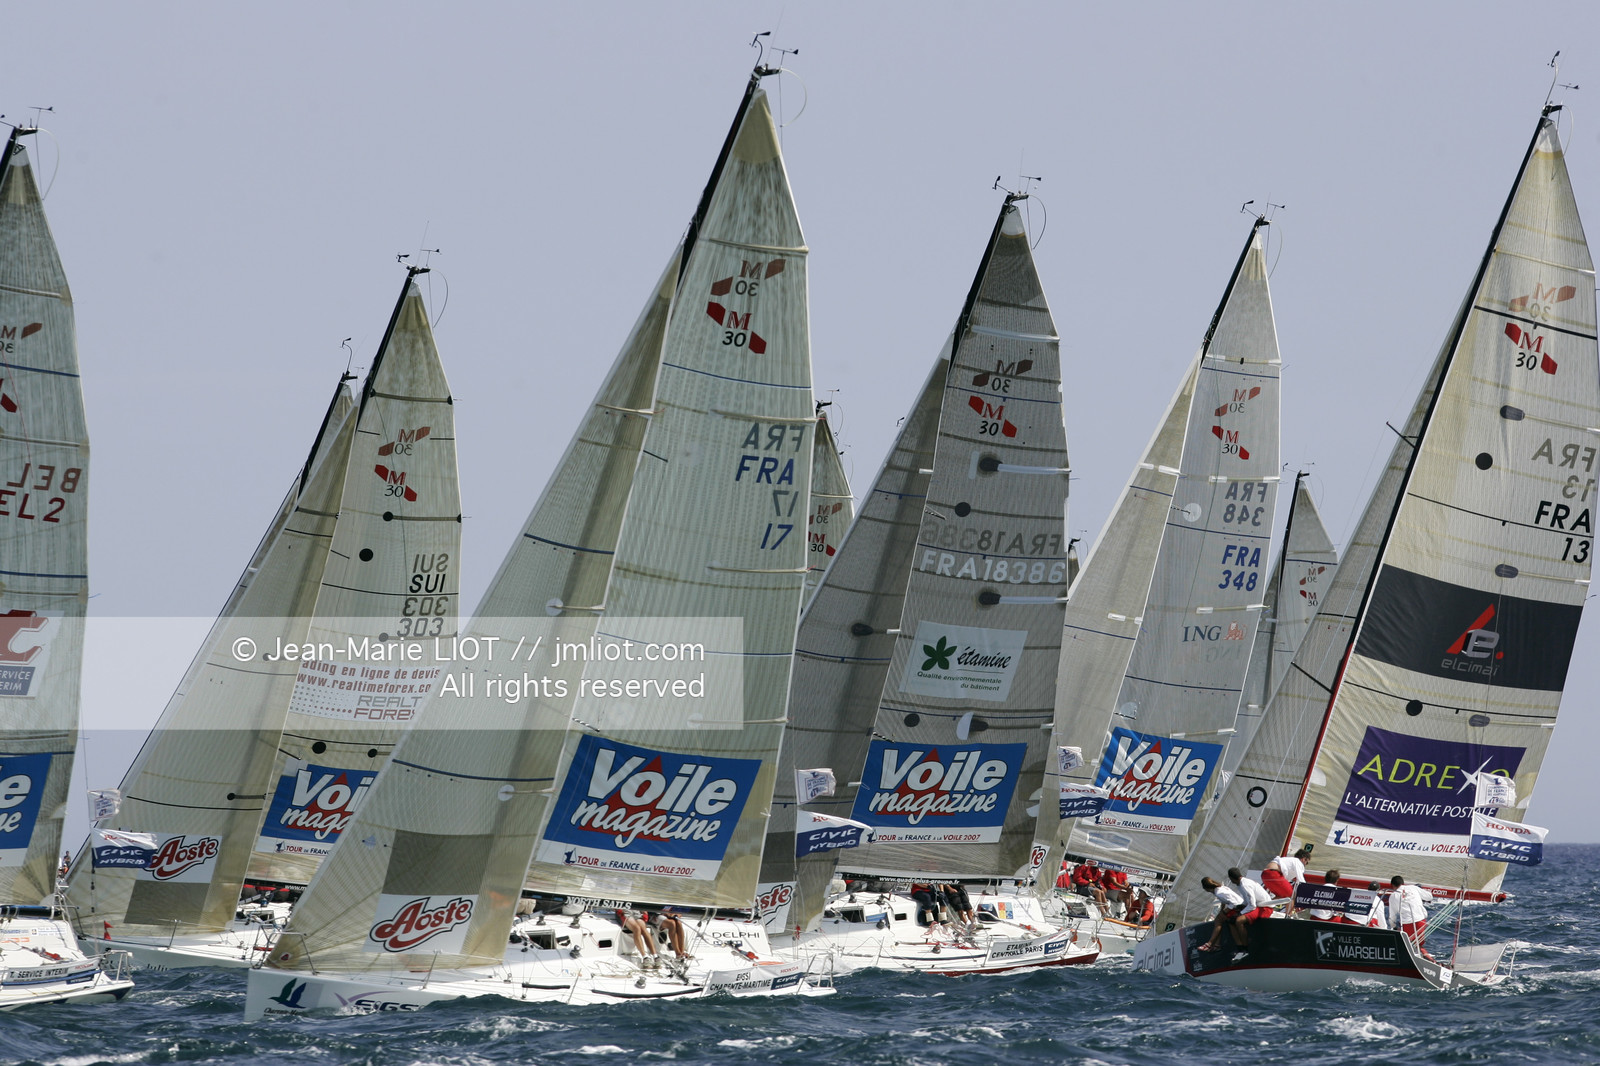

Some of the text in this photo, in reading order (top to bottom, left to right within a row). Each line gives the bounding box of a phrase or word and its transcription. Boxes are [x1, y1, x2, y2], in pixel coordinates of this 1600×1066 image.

[727, 311, 752, 330] M
[722, 331, 746, 347] 30
[1519, 331, 1544, 353] M
[1516, 352, 1537, 370] 30
[982, 403, 1005, 420] M
[979, 421, 999, 436] 30
[1225, 430, 1239, 443] M
[1222, 443, 1238, 454] 30
[388, 471, 406, 485] M
[735, 455, 794, 485] FRA
[384, 485, 404, 497] 30
[43, 497, 65, 523] 2
[1534, 500, 1590, 533] FRA
[760, 523, 794, 550] 17
[811, 544, 824, 552] 30
[1221, 545, 1261, 568] FRA
[1562, 537, 1590, 563] 13
[919, 549, 1066, 584] FRA18386
[409, 573, 446, 593] SUI
[1218, 570, 1258, 592] 348
[396, 617, 444, 637] 303
[1182, 625, 1222, 643] ING
[956, 646, 1011, 668] étamine
[341, 666, 356, 677] en
[360, 667, 390, 680] ligne
[394, 668, 407, 679] de
[917, 671, 1002, 684] Qualité environnementale
[880, 749, 1008, 791] Voile
[1111, 736, 1206, 787] Voile
[588, 748, 737, 815] Voile
[1101, 776, 1195, 811] magazine
[869, 789, 998, 824] magazine
[1345, 792, 1441, 817] L'ALTERNATIVE
[571, 800, 721, 848] magazine
[1486, 822, 1531, 834] HONDA
[809, 828, 857, 841] CIVIC
[286, 845, 303, 853] TOUR
[809, 840, 856, 851] HYBRID
[1348, 835, 1373, 846] TOUR
[1383, 840, 1417, 850] FRANCE
[1431, 844, 1455, 853] VOILE
[1480, 839, 1532, 852] CIVIC
[148, 837, 218, 872] Aoste
[1479, 849, 1530, 861] HYBRID
[577, 855, 599, 866] TOUR
[608, 860, 640, 870] FRANCE
[653, 865, 675, 874] VOILE
[676, 867, 696, 875] 2007
[602, 899, 632, 910] SAILS
[374, 901, 470, 941] Aoste
[1025, 945, 1043, 953] PARIS
[1338, 936, 1361, 944] VILLE DE
[1338, 945, 1396, 960] MARSEILLE
[18, 970, 43, 978] SERVICE
